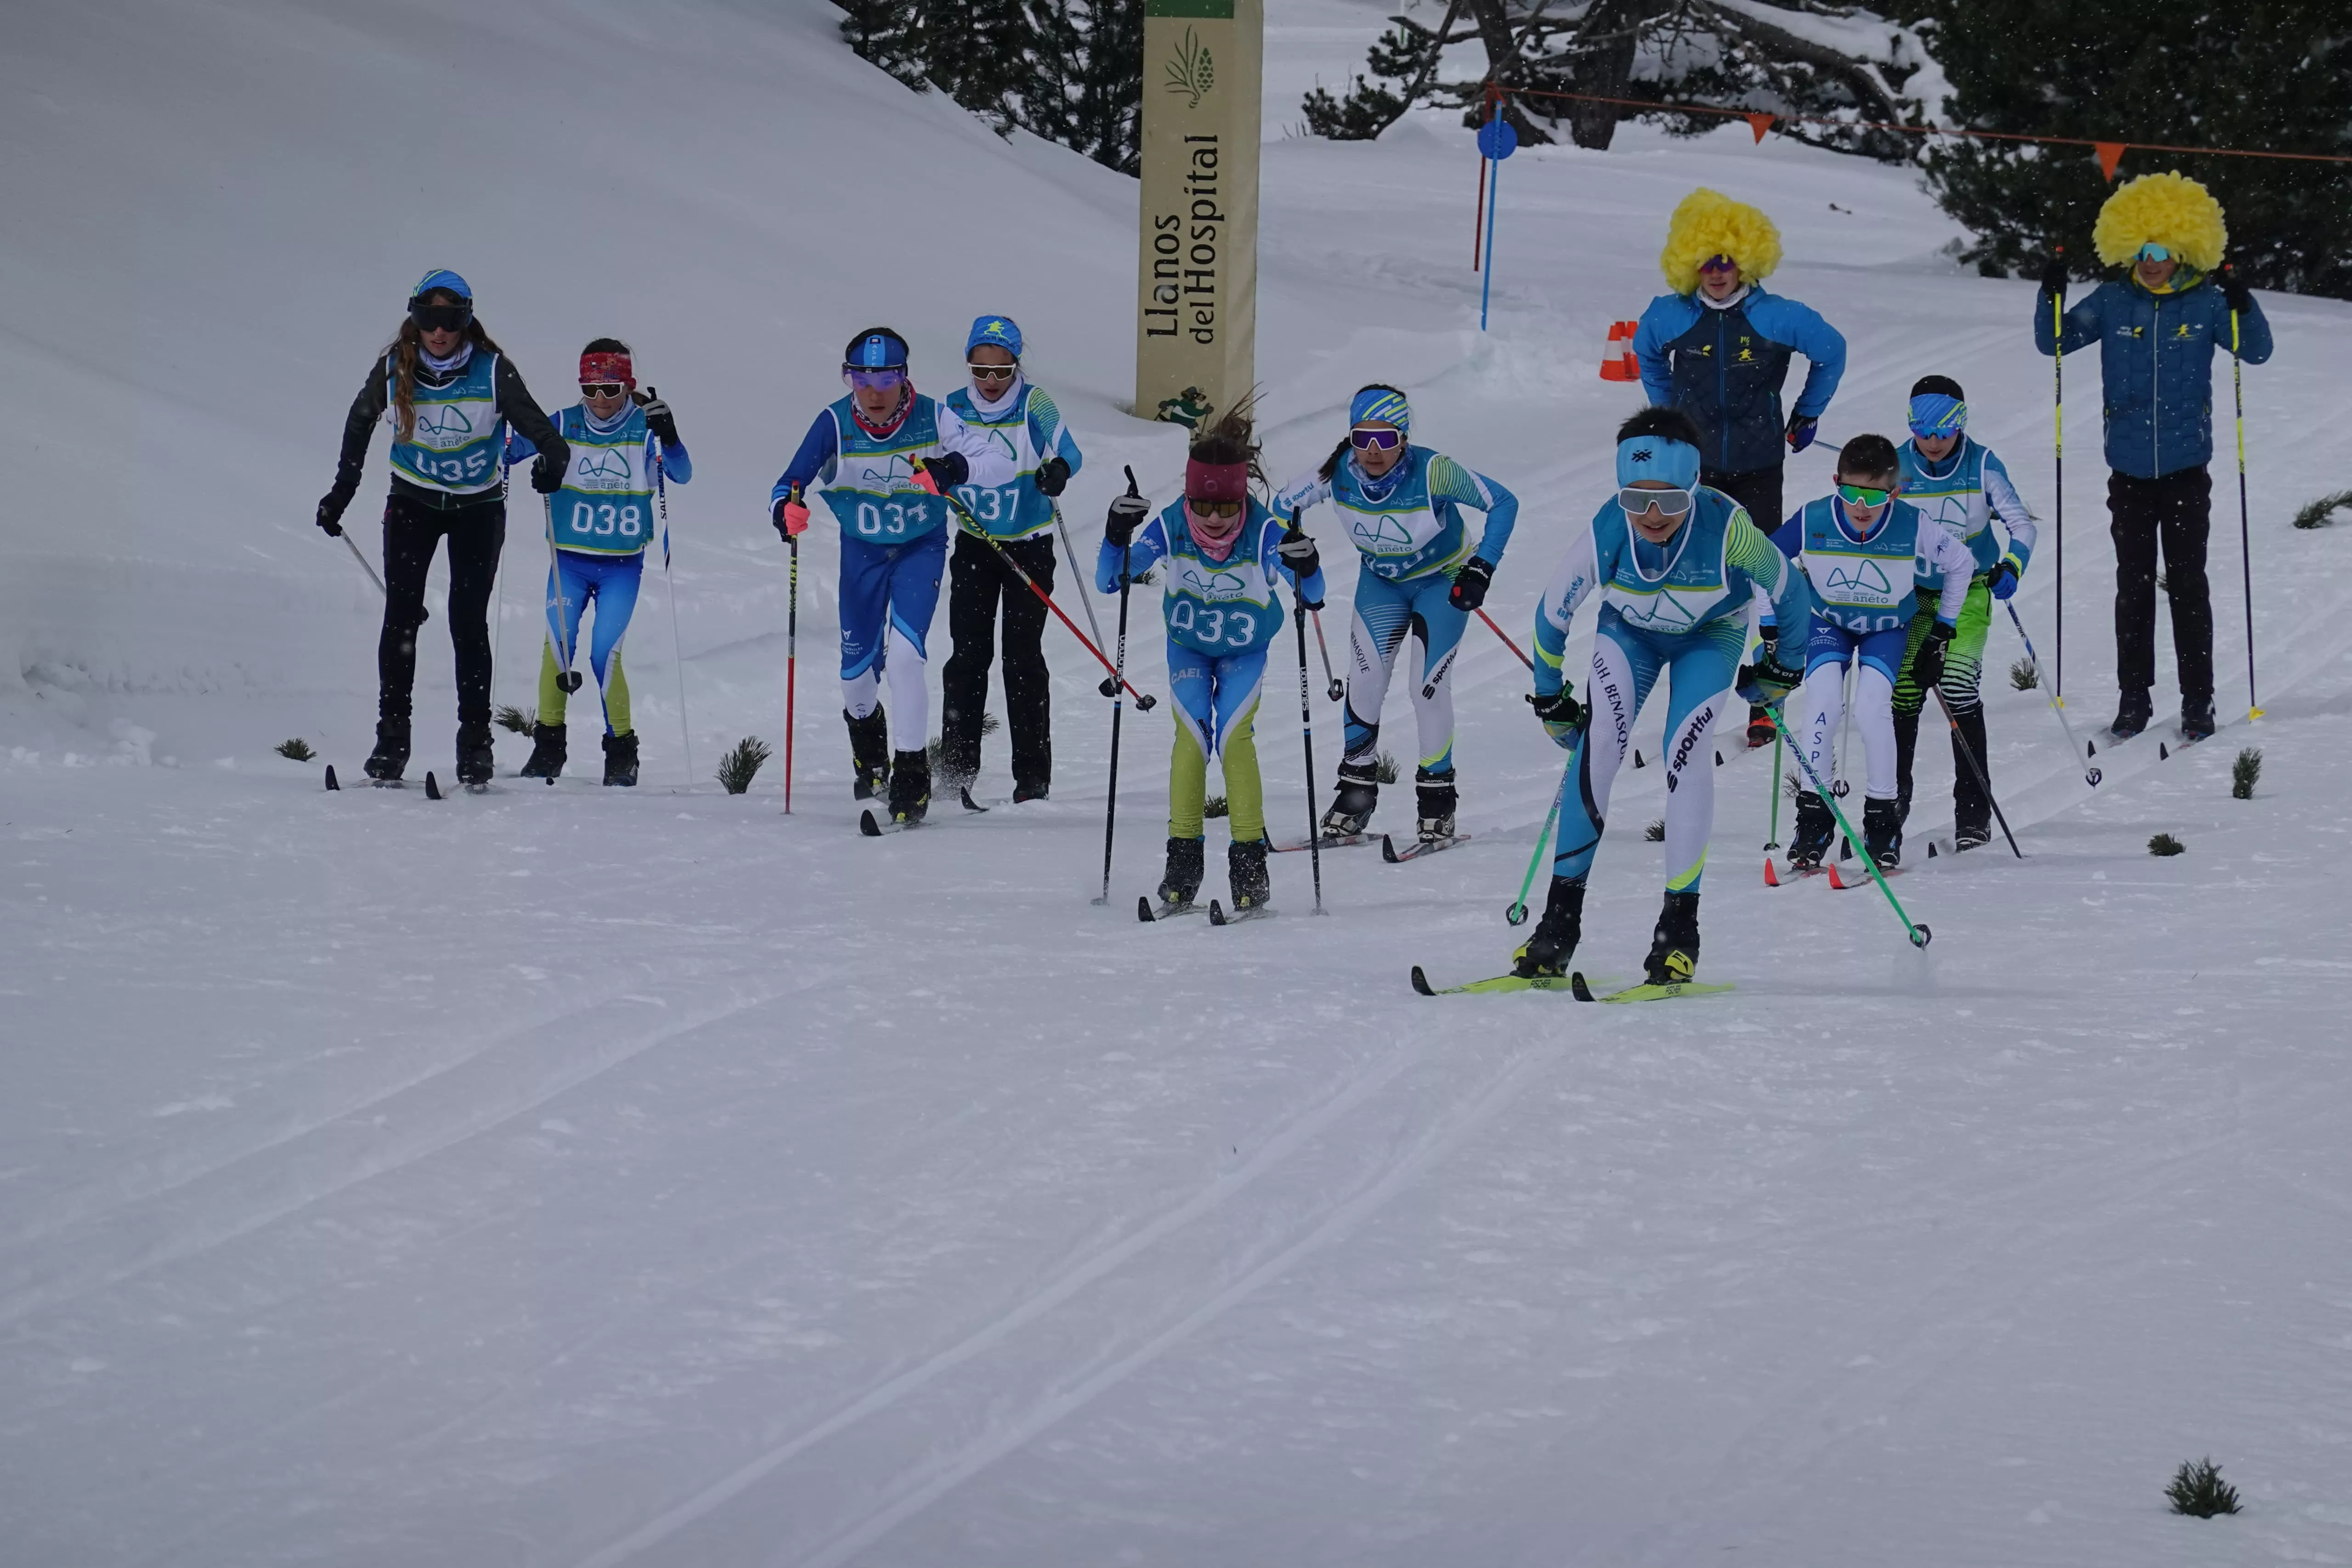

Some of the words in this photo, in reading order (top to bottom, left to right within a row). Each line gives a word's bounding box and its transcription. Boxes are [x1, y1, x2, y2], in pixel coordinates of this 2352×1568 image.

[1184, 135, 1224, 294] Hospital
[1145, 214, 1180, 338] Llanos
[1189, 303, 1214, 345] del
[601, 481, 630, 490] aneto
[956, 485, 1020, 522] 037
[571, 501, 642, 537] 038
[856, 500, 929, 536] 034
[981, 530, 1002, 551] LEKI
[1169, 599, 1257, 648] 033
[1117, 634, 1125, 682] salomon
[1300, 667, 1309, 711] salomon
[1673, 707, 1713, 772] sportful
[1811, 712, 1826, 772] ASP
[1530, 979, 1551, 988] FISCHER
[1665, 985, 1681, 996] FISCHER
